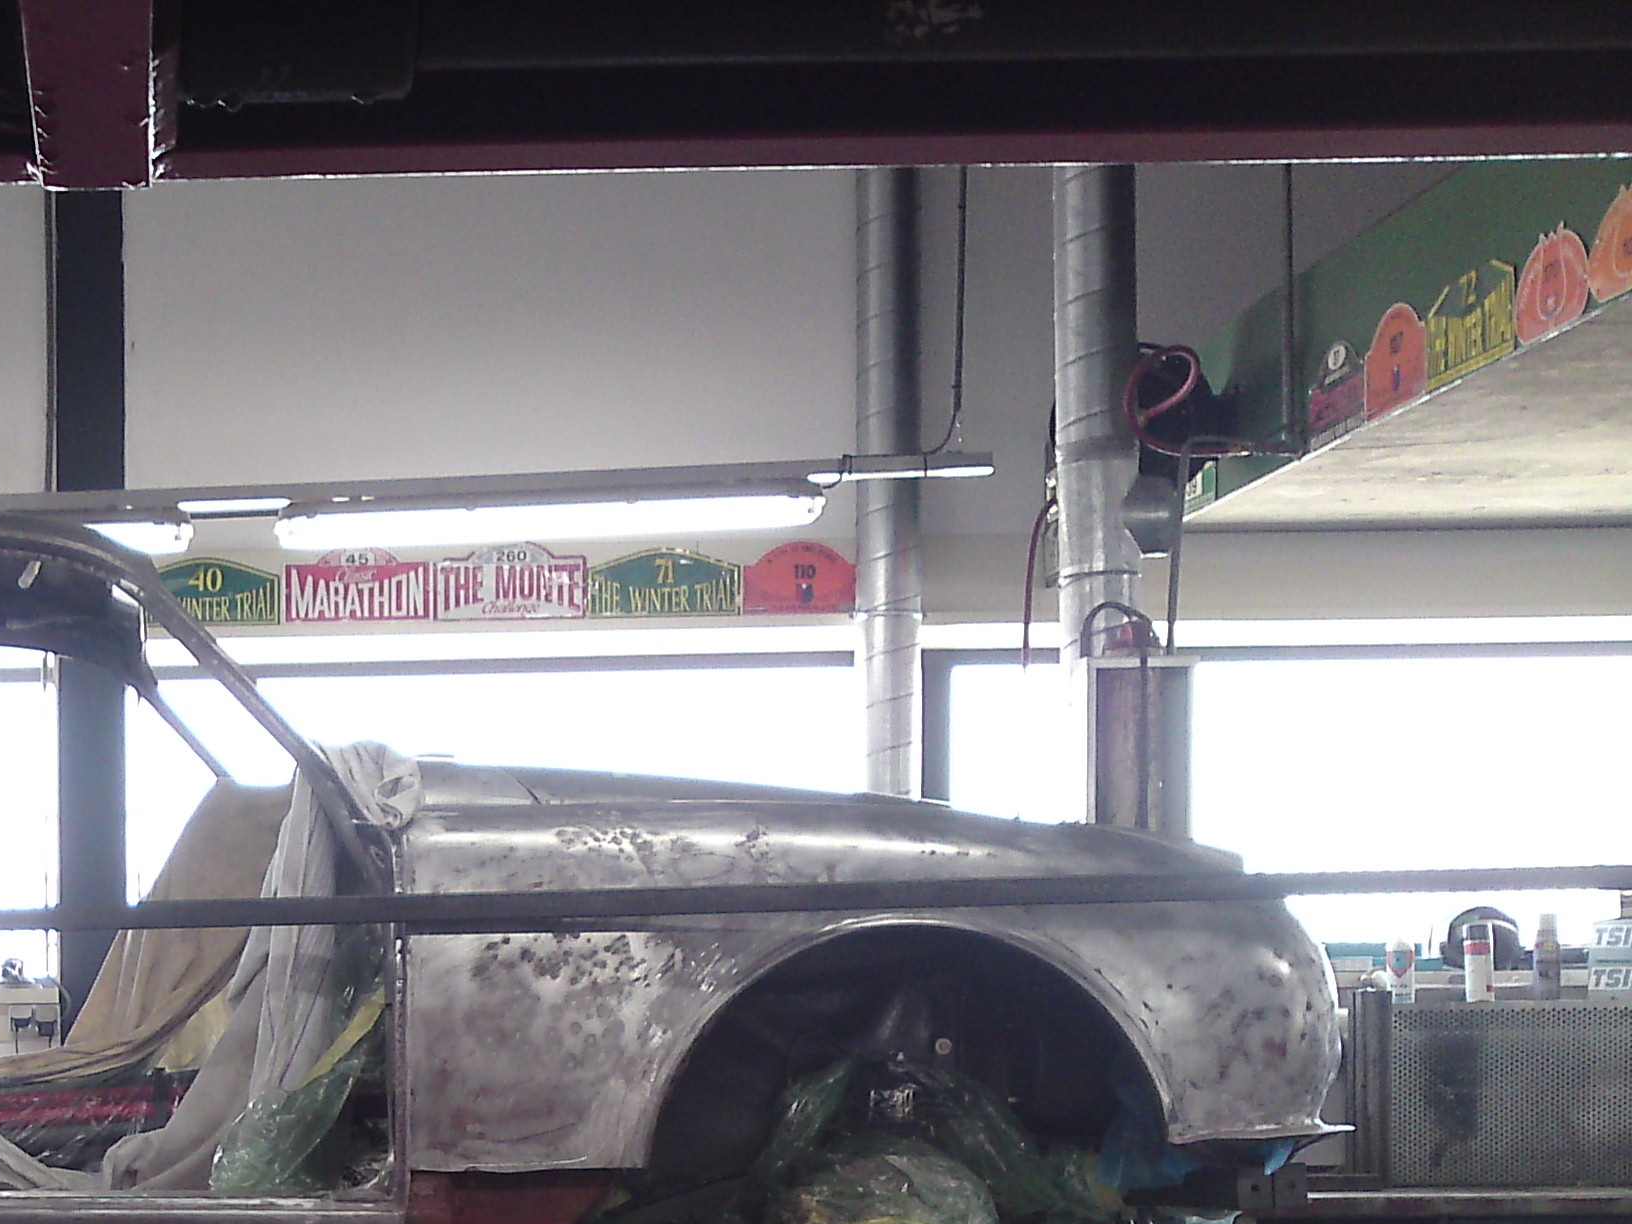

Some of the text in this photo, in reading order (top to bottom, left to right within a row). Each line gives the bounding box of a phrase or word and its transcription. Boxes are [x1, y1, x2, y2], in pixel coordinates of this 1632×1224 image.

[345, 553, 369, 565] 45
[496, 550, 527, 562] 260
[188, 566, 223, 592] 40
[654, 557, 675, 584] 71
[794, 564, 817, 579] 110
[234, 581, 276, 620] TRIAL
[290, 565, 425, 619] MARATHON
[440, 563, 581, 612] THE MONTE
[590, 573, 736, 614] THE WINTER TRIAL
